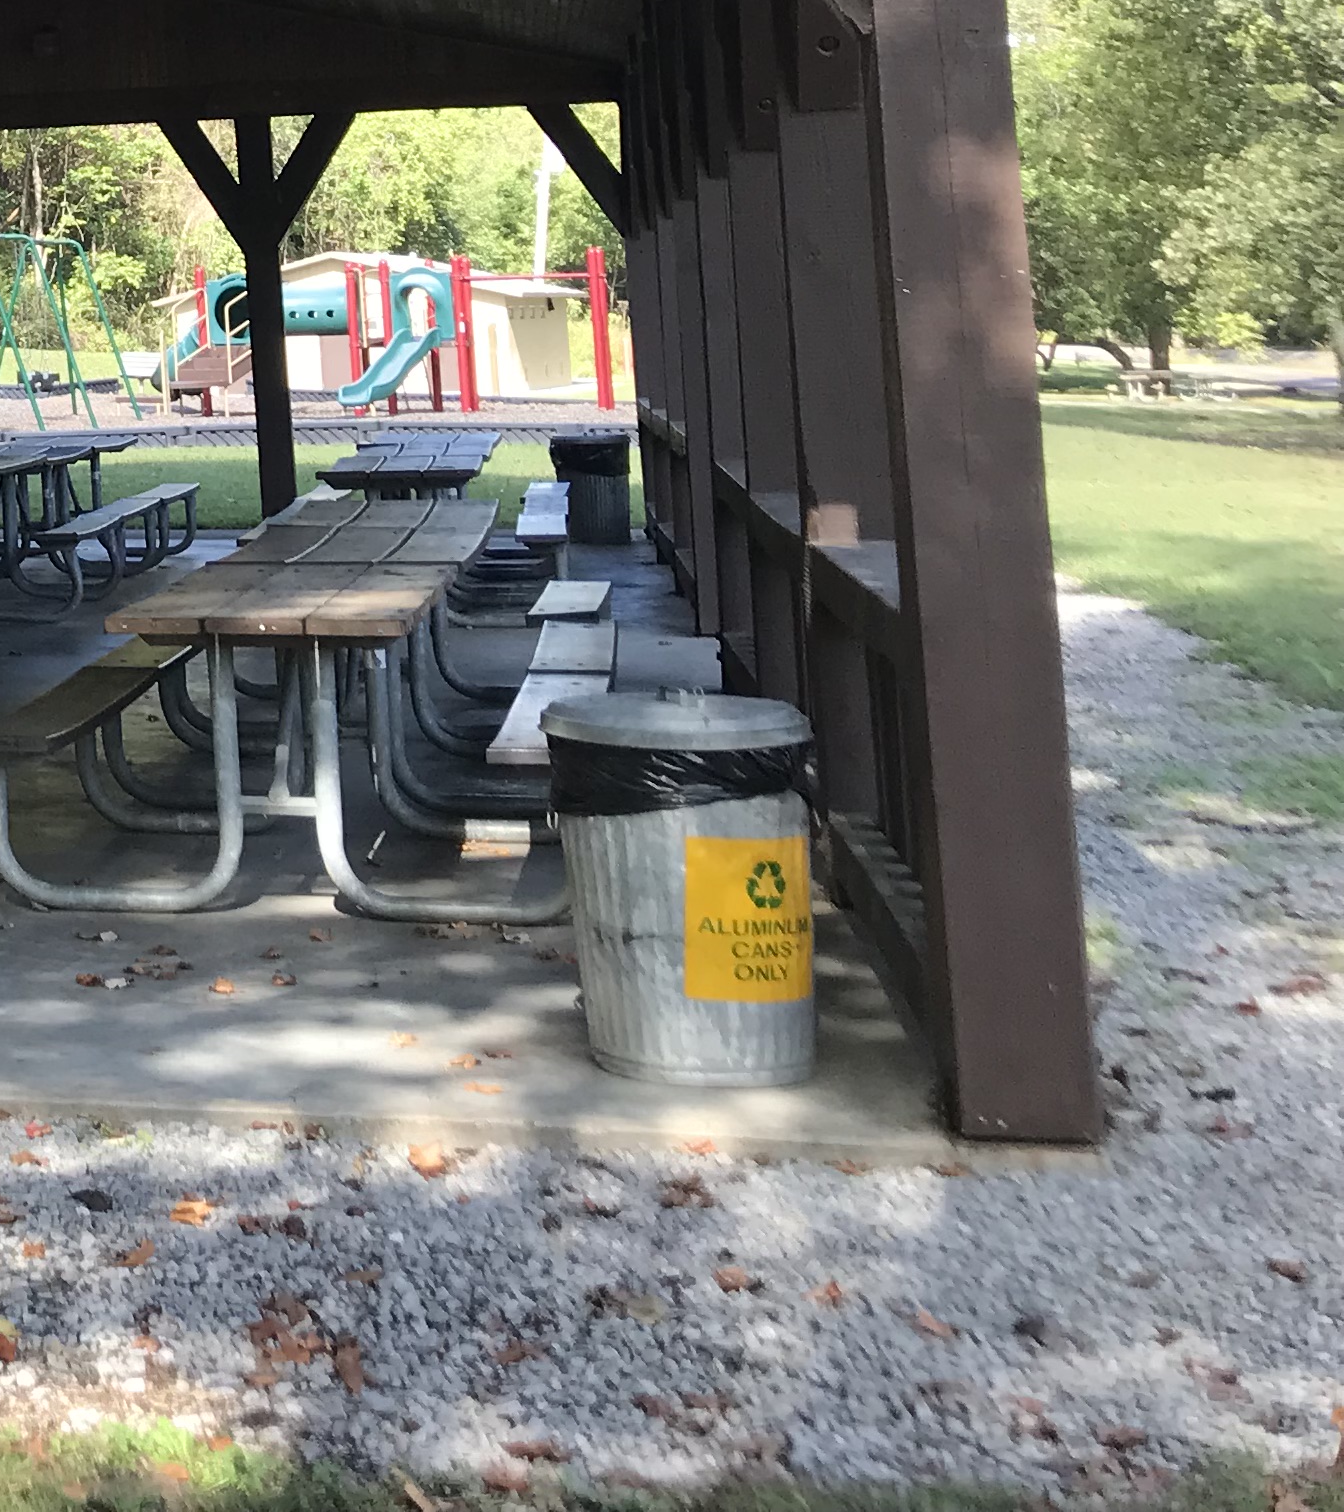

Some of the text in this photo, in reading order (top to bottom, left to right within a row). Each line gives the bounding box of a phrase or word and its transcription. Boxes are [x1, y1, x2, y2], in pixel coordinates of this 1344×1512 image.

[698, 916, 809, 936] ALUMINUM
[731, 941, 793, 960] CANS
[733, 963, 789, 982] ONLY
